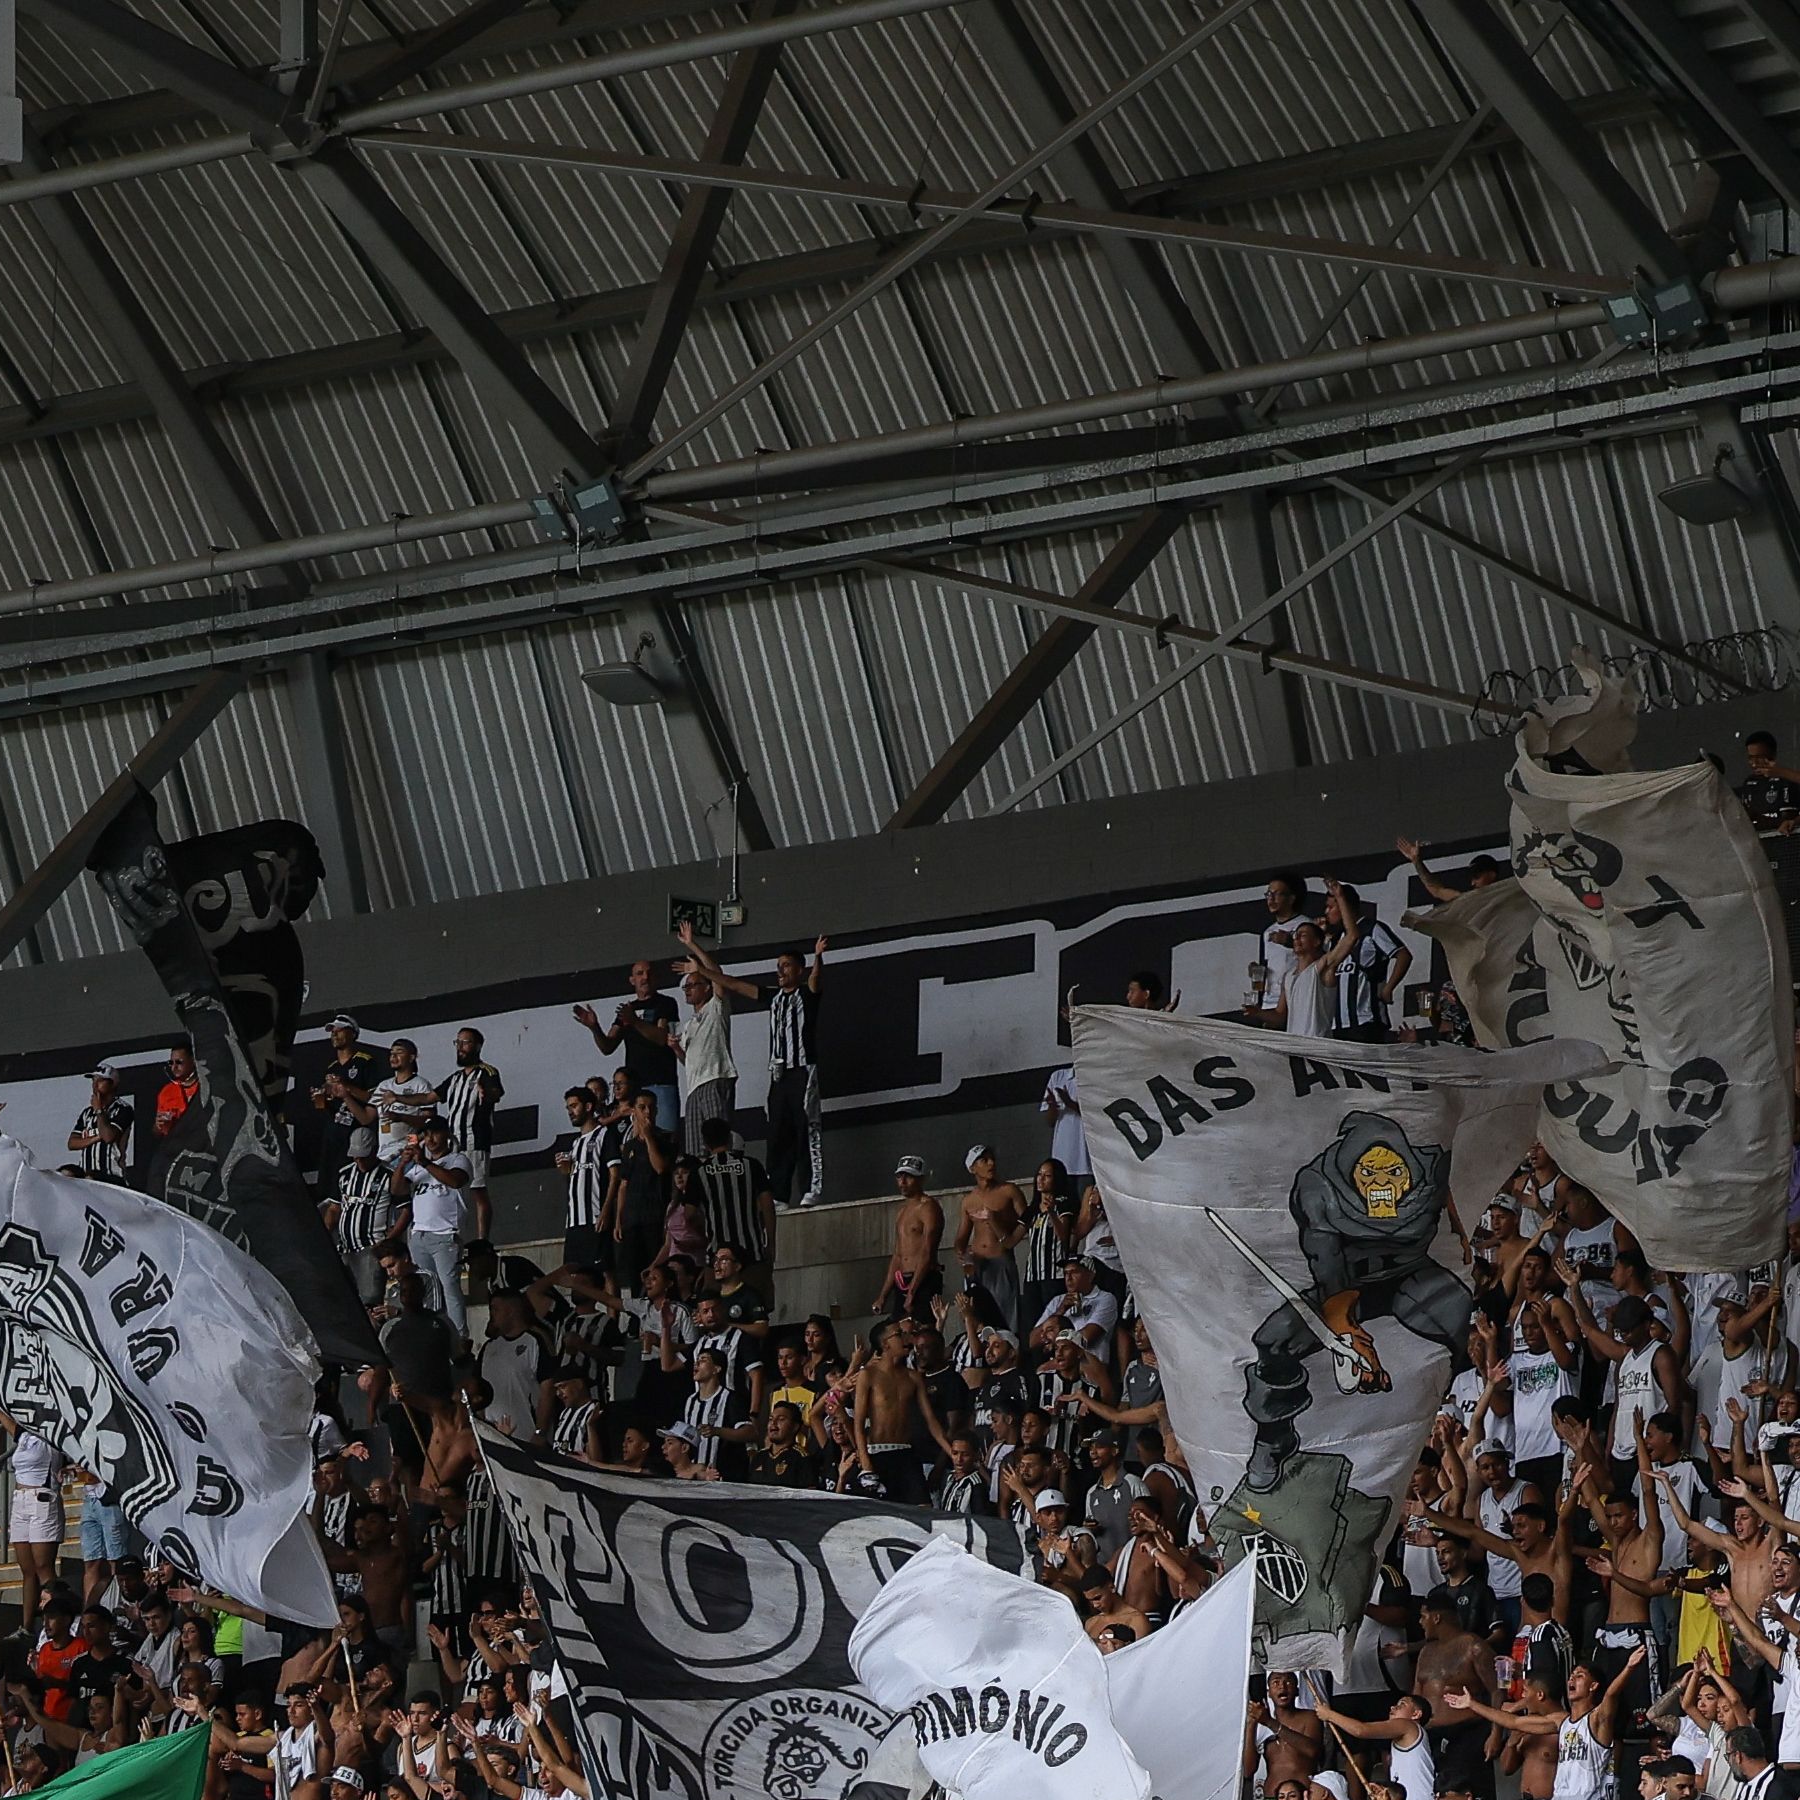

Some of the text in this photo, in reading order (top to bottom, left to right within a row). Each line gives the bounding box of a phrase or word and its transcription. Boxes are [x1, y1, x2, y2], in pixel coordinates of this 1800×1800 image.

[1104, 1056, 1258, 1161] DAS
[715, 1162, 743, 1176] bmg
[713, 1696, 890, 1792] TORCIDA ORGANIZA
